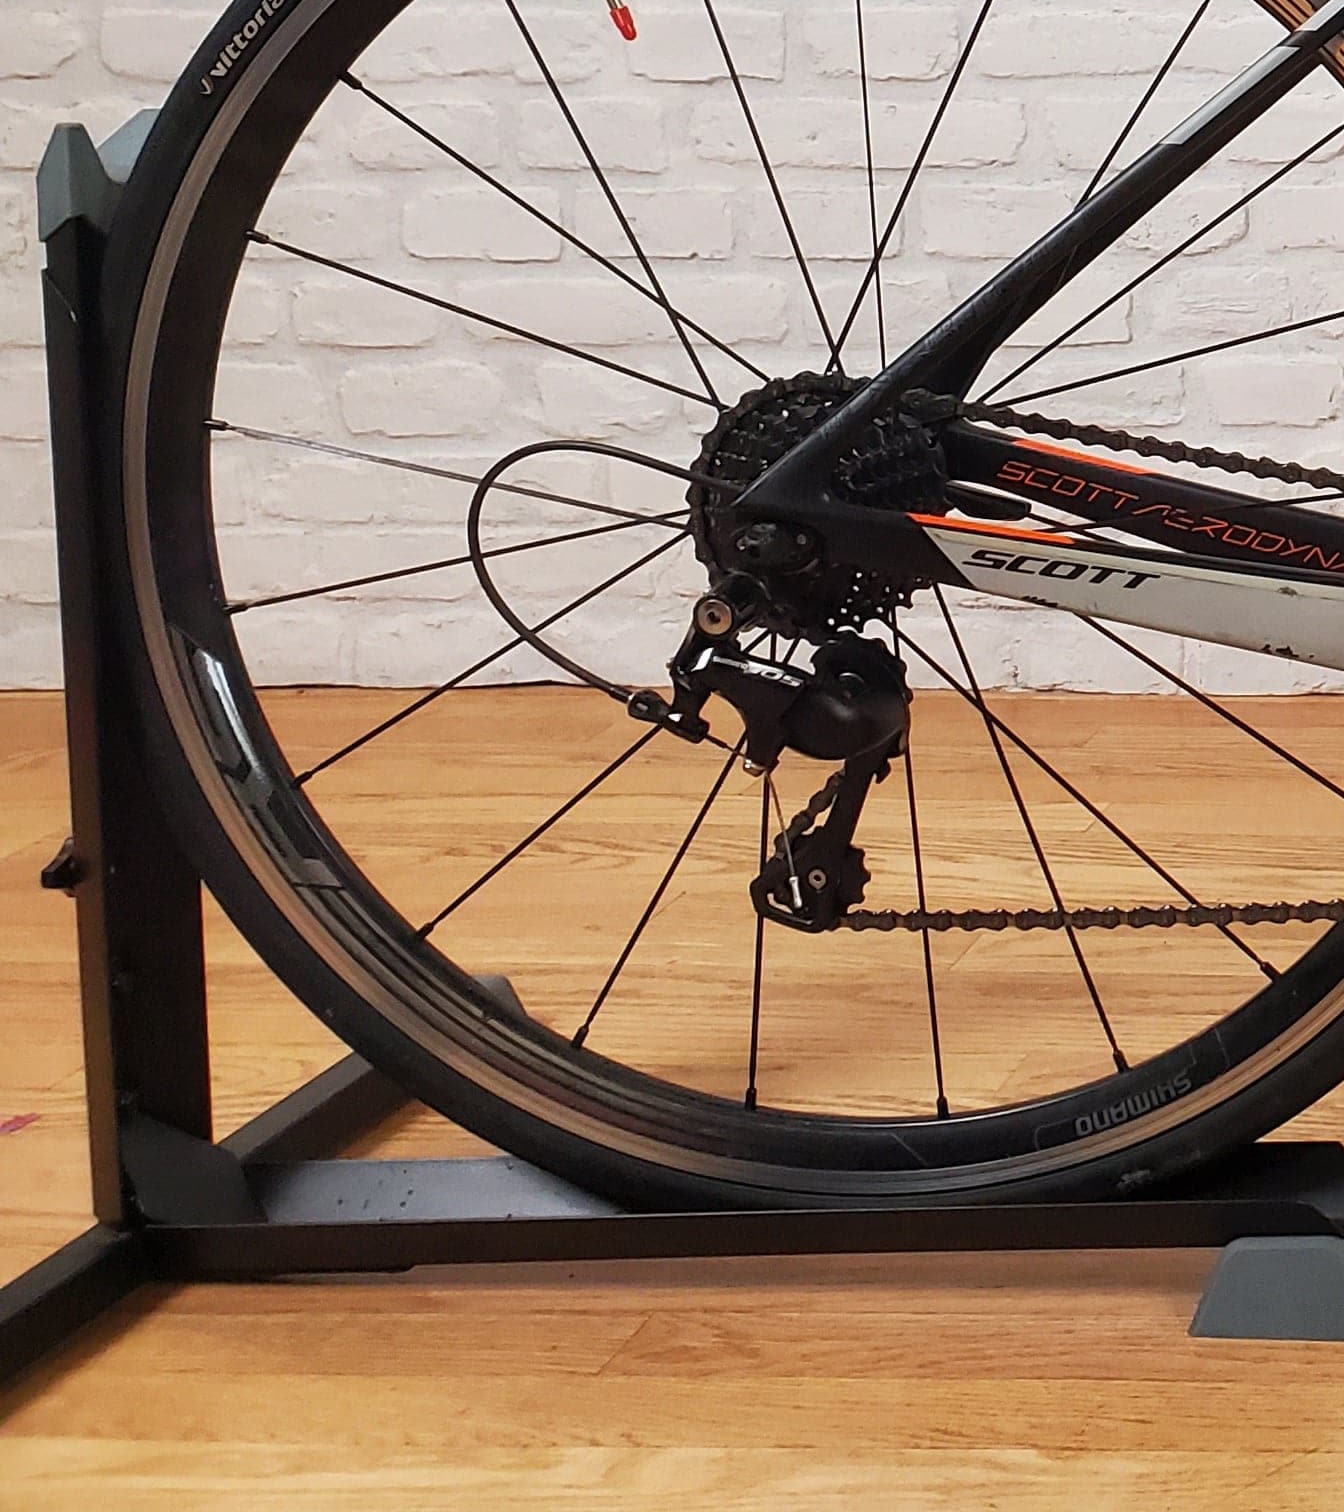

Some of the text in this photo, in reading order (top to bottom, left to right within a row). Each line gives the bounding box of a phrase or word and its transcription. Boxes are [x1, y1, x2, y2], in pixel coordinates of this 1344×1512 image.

[996, 459, 1140, 510] SCOTT
[962, 549, 1164, 589] SCOTT
[1074, 1071, 1193, 1137] SHIMANO
